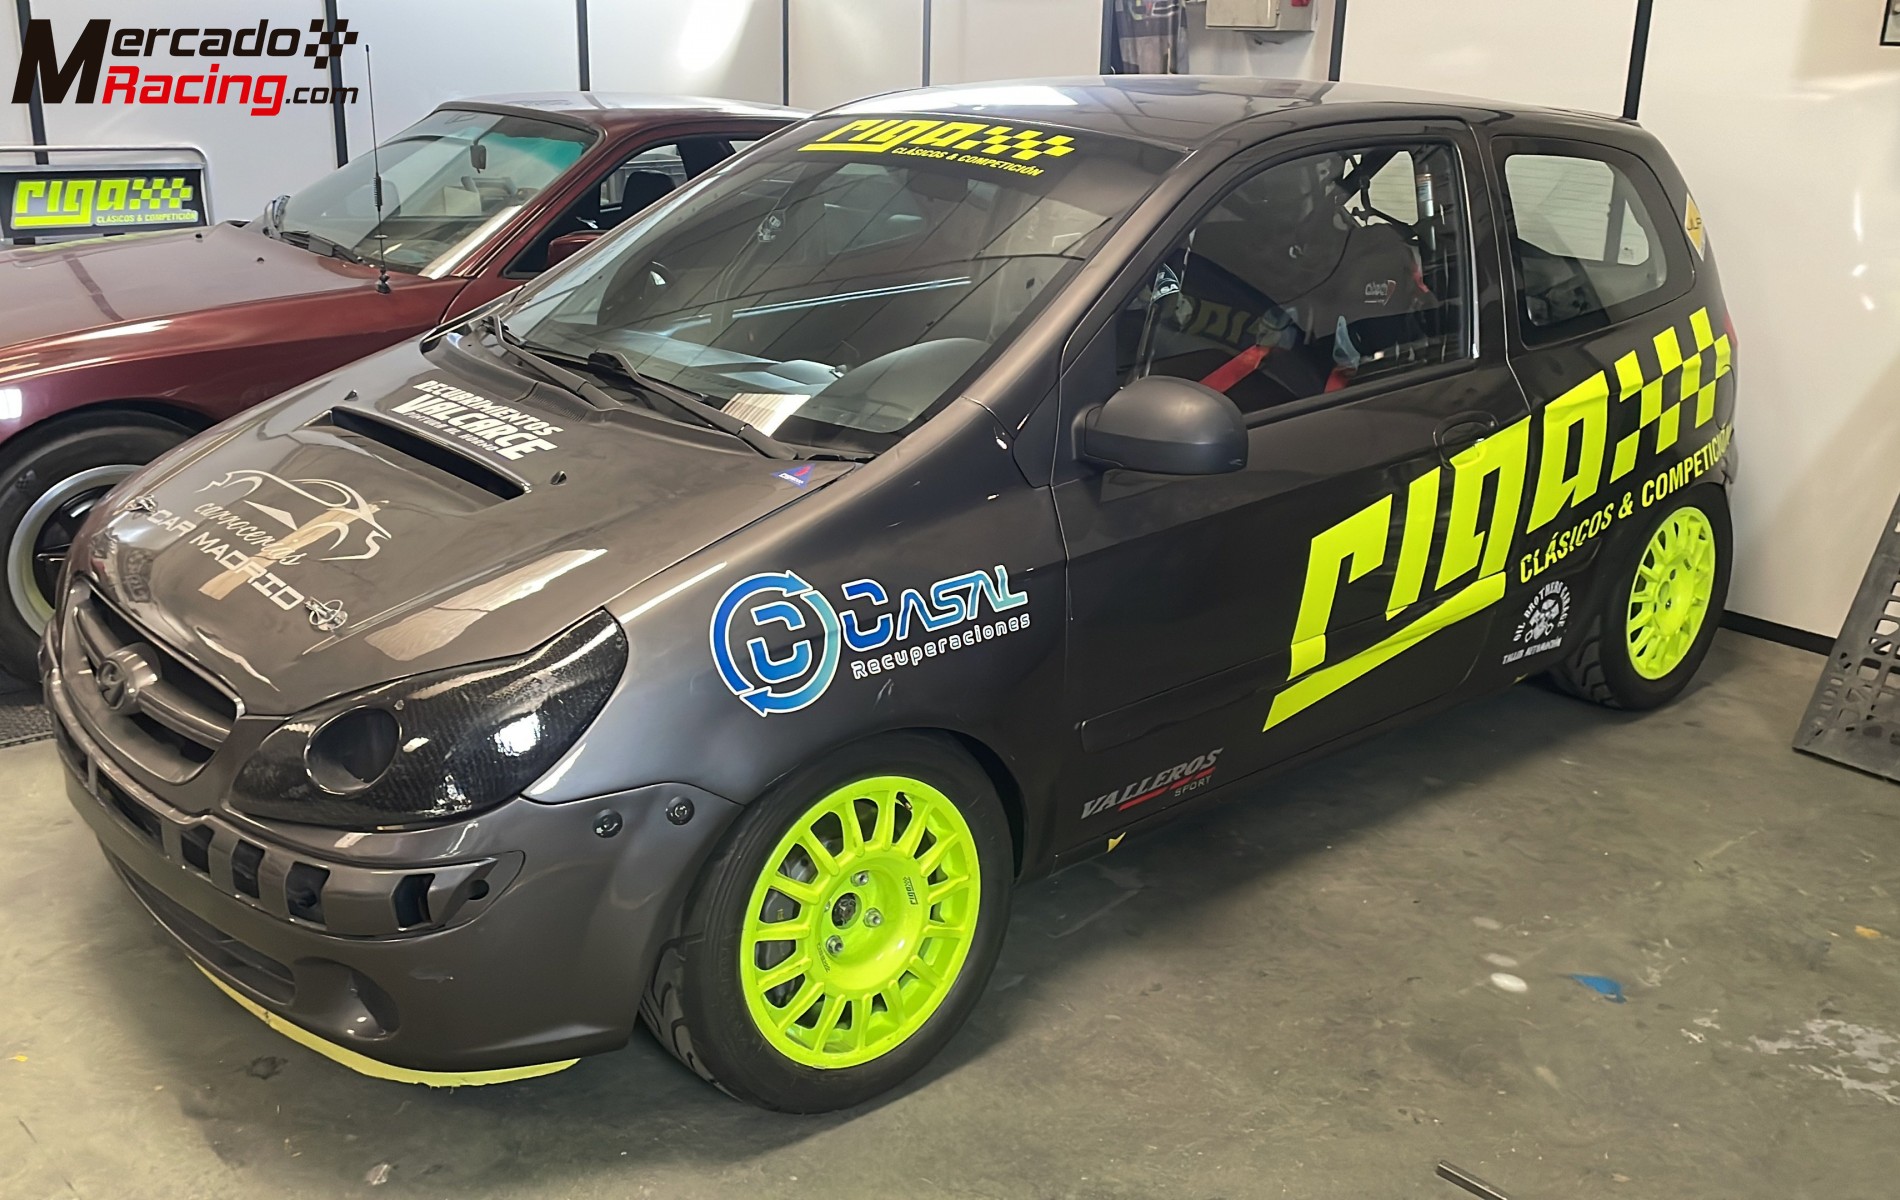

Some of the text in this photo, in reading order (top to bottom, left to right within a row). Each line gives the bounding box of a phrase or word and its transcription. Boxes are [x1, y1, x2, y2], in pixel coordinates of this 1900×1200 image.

[797, 119, 990, 153] riga
[891, 146, 1044, 177] CLÁSICOS & COMPETICIÓN
[14, 179, 130, 227] riga
[391, 393, 558, 461] VALCARCE
[413, 380, 564, 436] RECUBRIMIENTOS
[148, 509, 305, 611] CAR MADRID
[1263, 371, 1610, 732] riga
[1520, 501, 1615, 583] CLÁSICOS
[1618, 491, 1634, 519] &
[851, 613, 1031, 679] Recuperaciones
[1080, 747, 1224, 819] VALLEROS
[1174, 775, 1212, 797] SPORT
